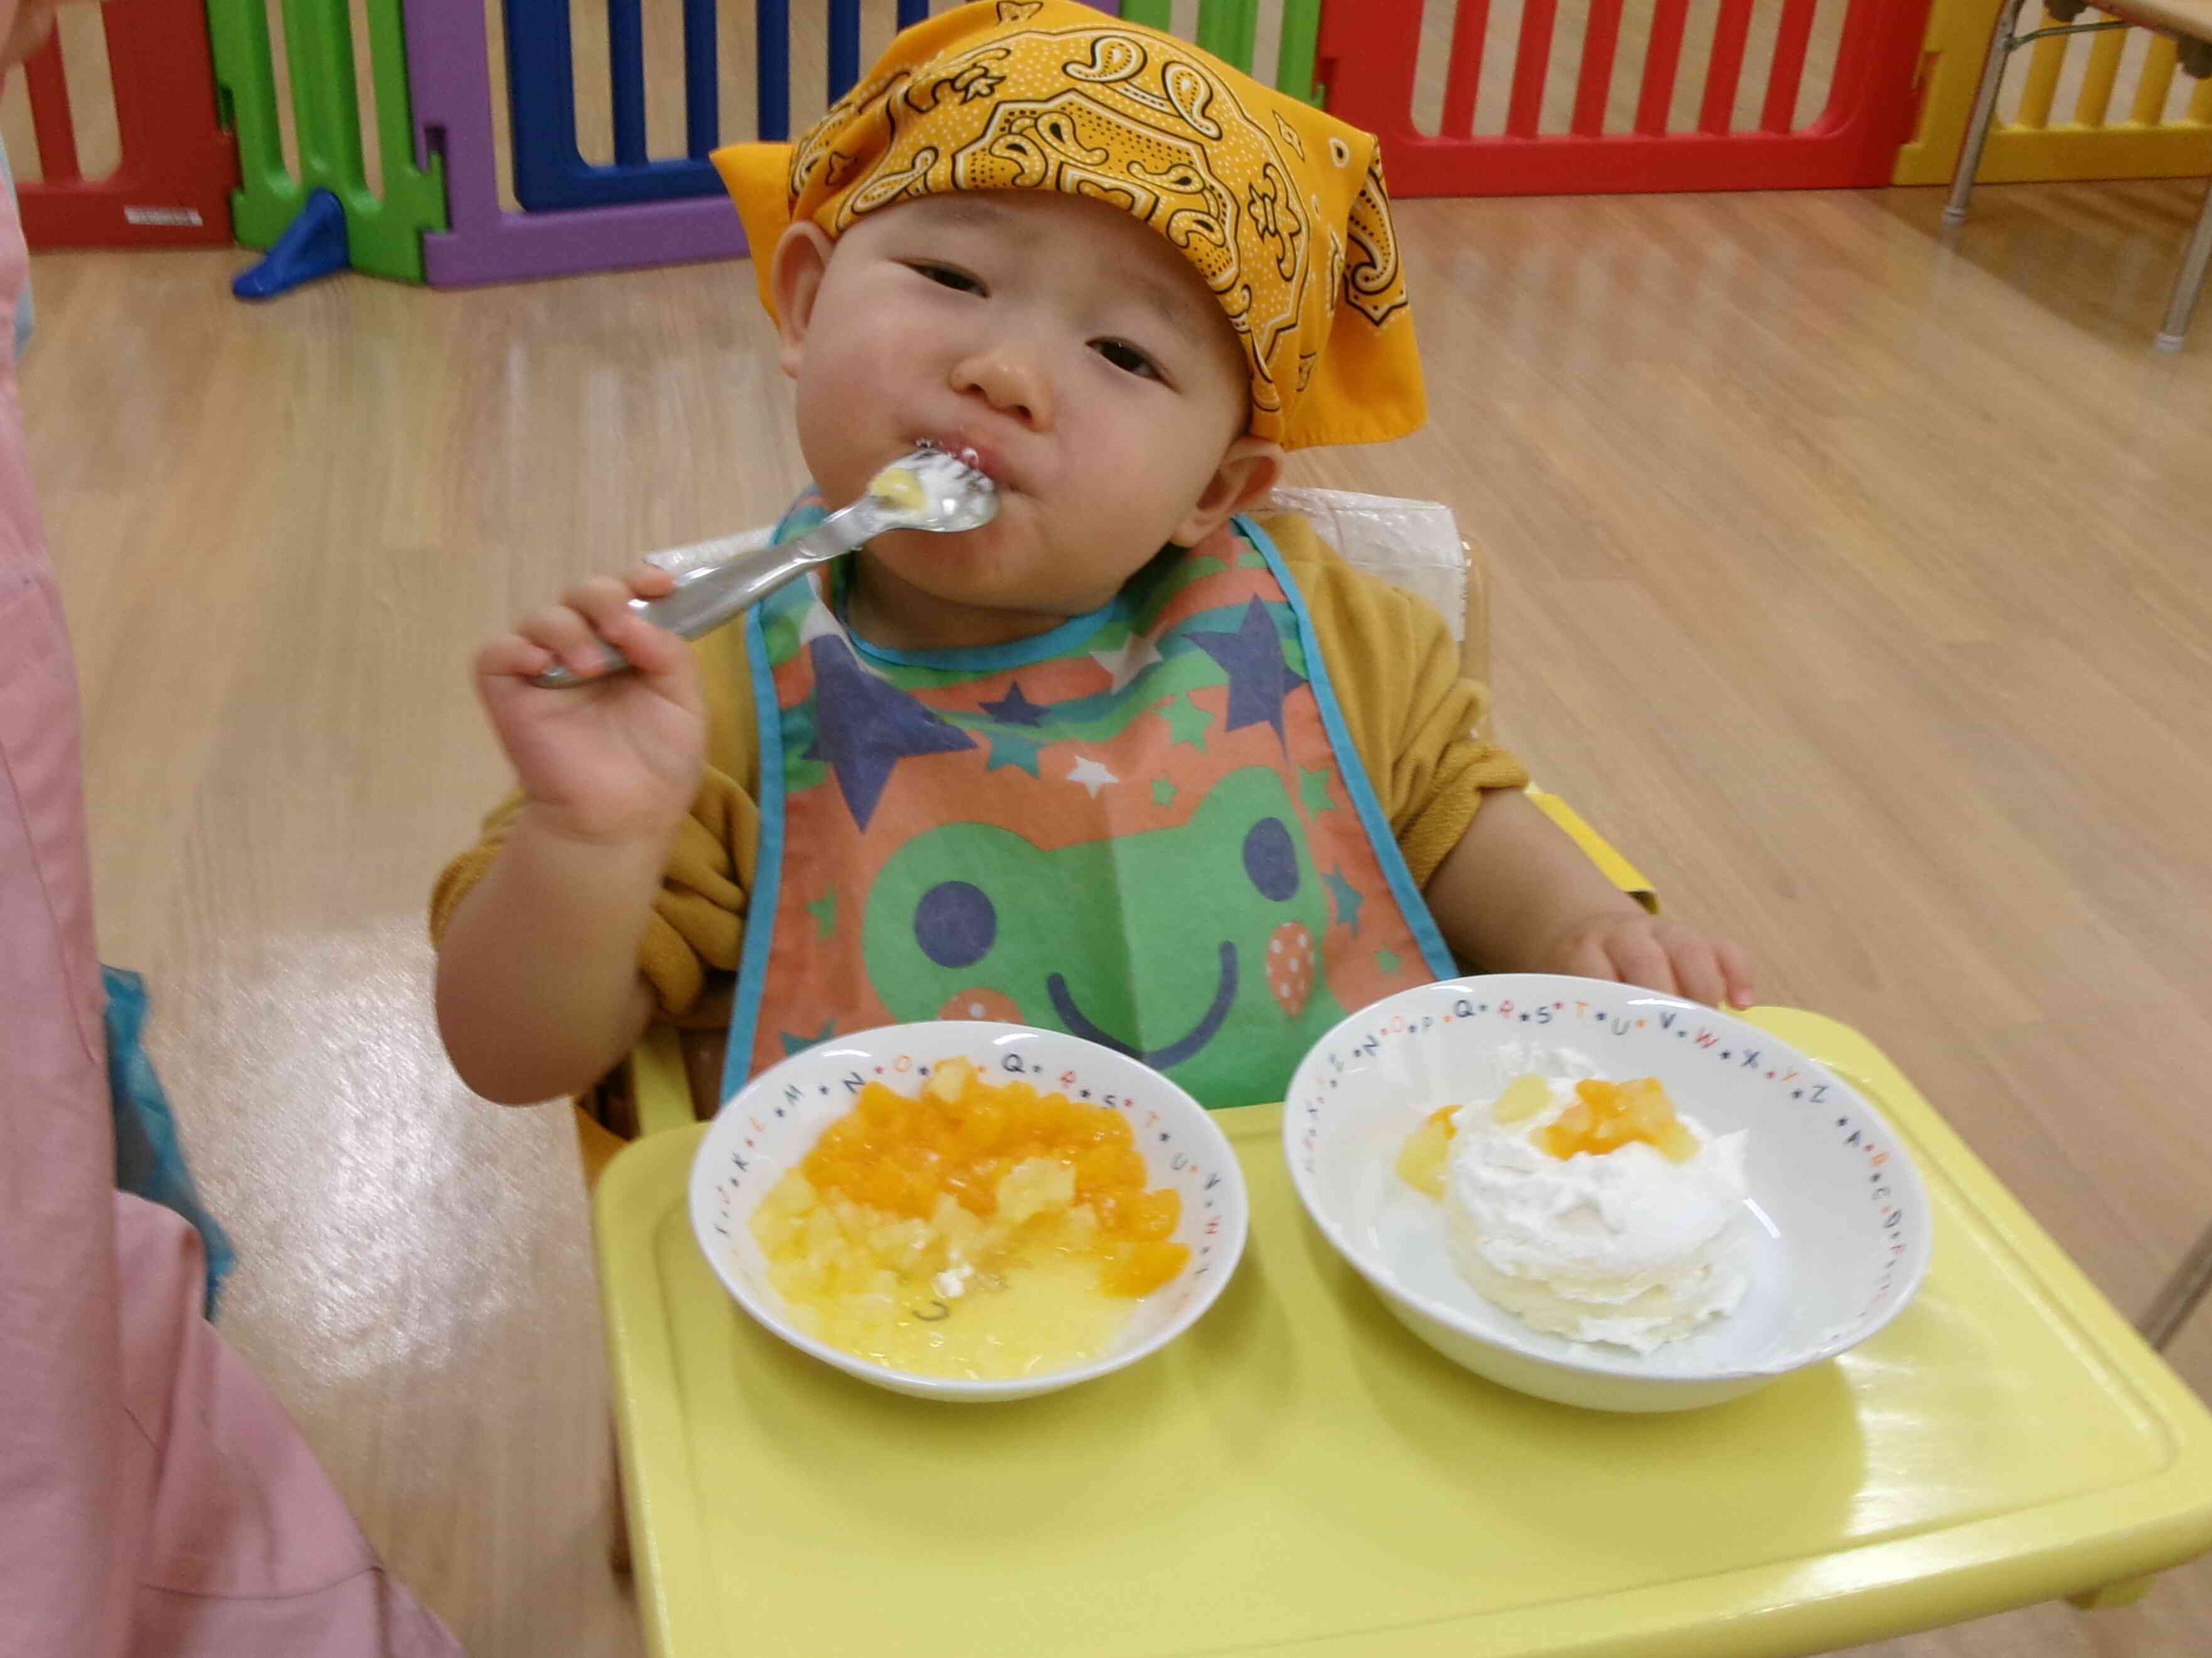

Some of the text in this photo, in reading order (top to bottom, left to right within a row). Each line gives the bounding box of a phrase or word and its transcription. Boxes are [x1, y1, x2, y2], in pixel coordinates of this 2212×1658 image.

[842, 1071, 866, 1094] N
[894, 1055, 911, 1072] O
[1003, 1053, 1026, 1074] Q
[1362, 1034, 1381, 1057] N
[1453, 999, 1475, 1019] Q
[1535, 1005, 1553, 1025] S
[1576, 1001, 1588, 1018] T
[1612, 1017, 1630, 1036] U
[1659, 1012, 1677, 1029] V
[1740, 1049, 1761, 1069] X
[1809, 1084, 1830, 1104] Z
